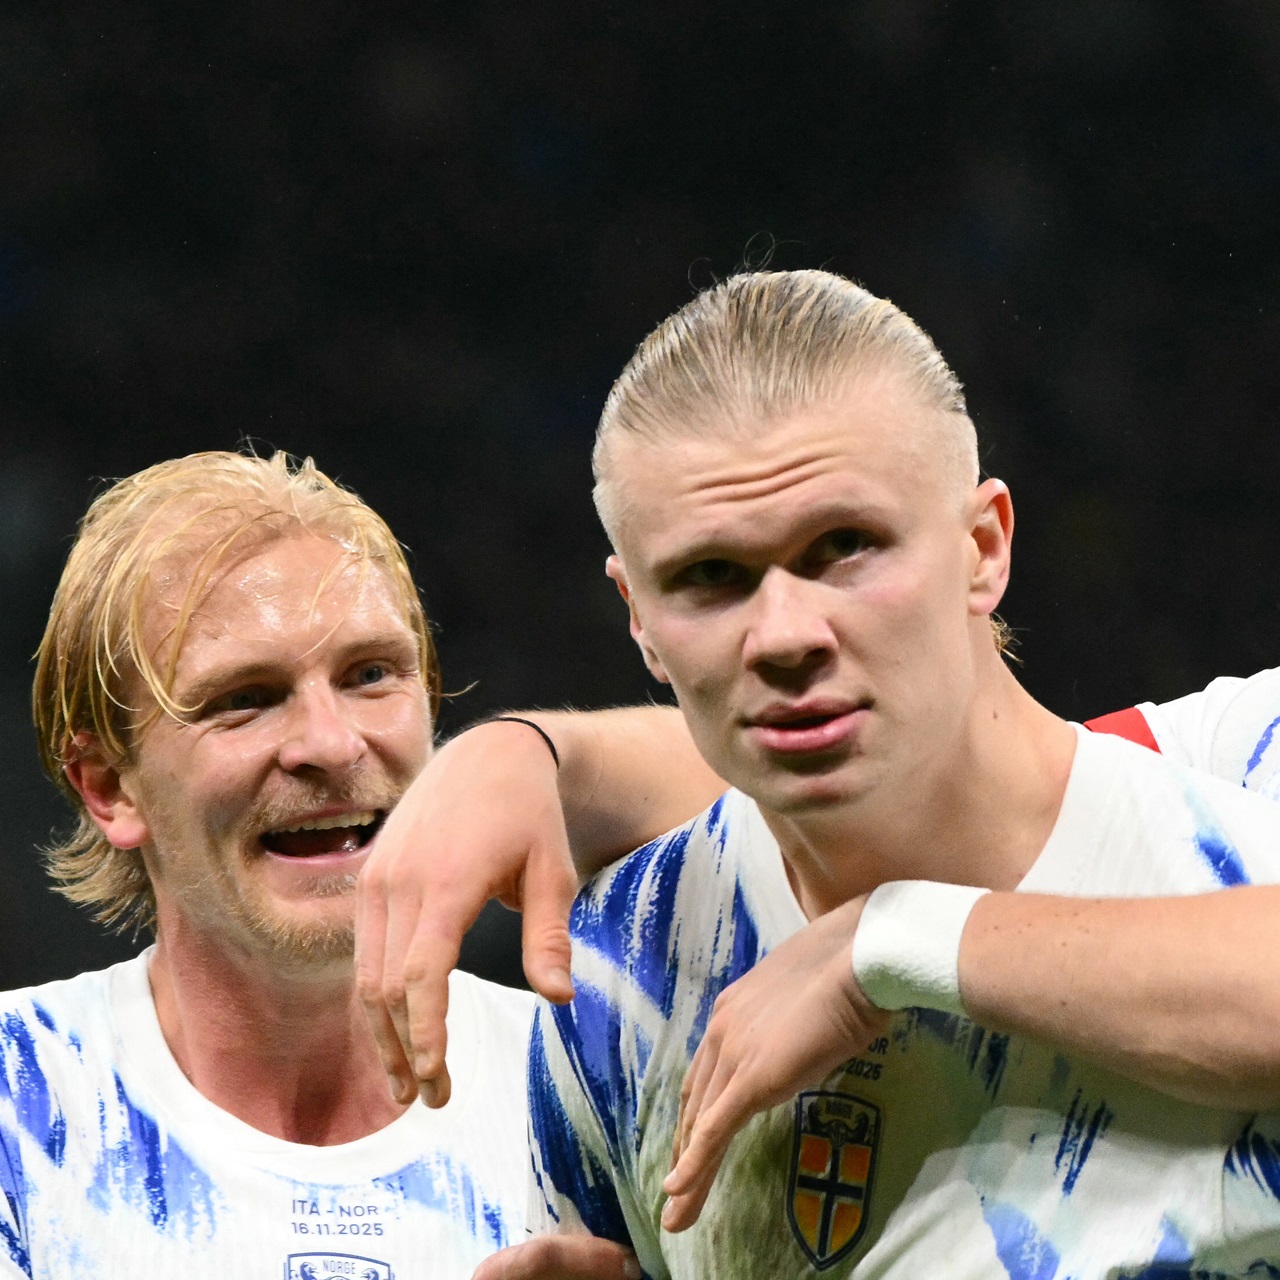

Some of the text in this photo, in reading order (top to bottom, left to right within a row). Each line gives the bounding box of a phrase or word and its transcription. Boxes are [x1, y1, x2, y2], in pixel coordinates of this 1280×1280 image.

[292, 1199, 321, 1216] ITA
[339, 1205, 380, 1218] NOR
[291, 1222, 384, 1237] 16.11.2025
[322, 1259, 357, 1276] NORGE
